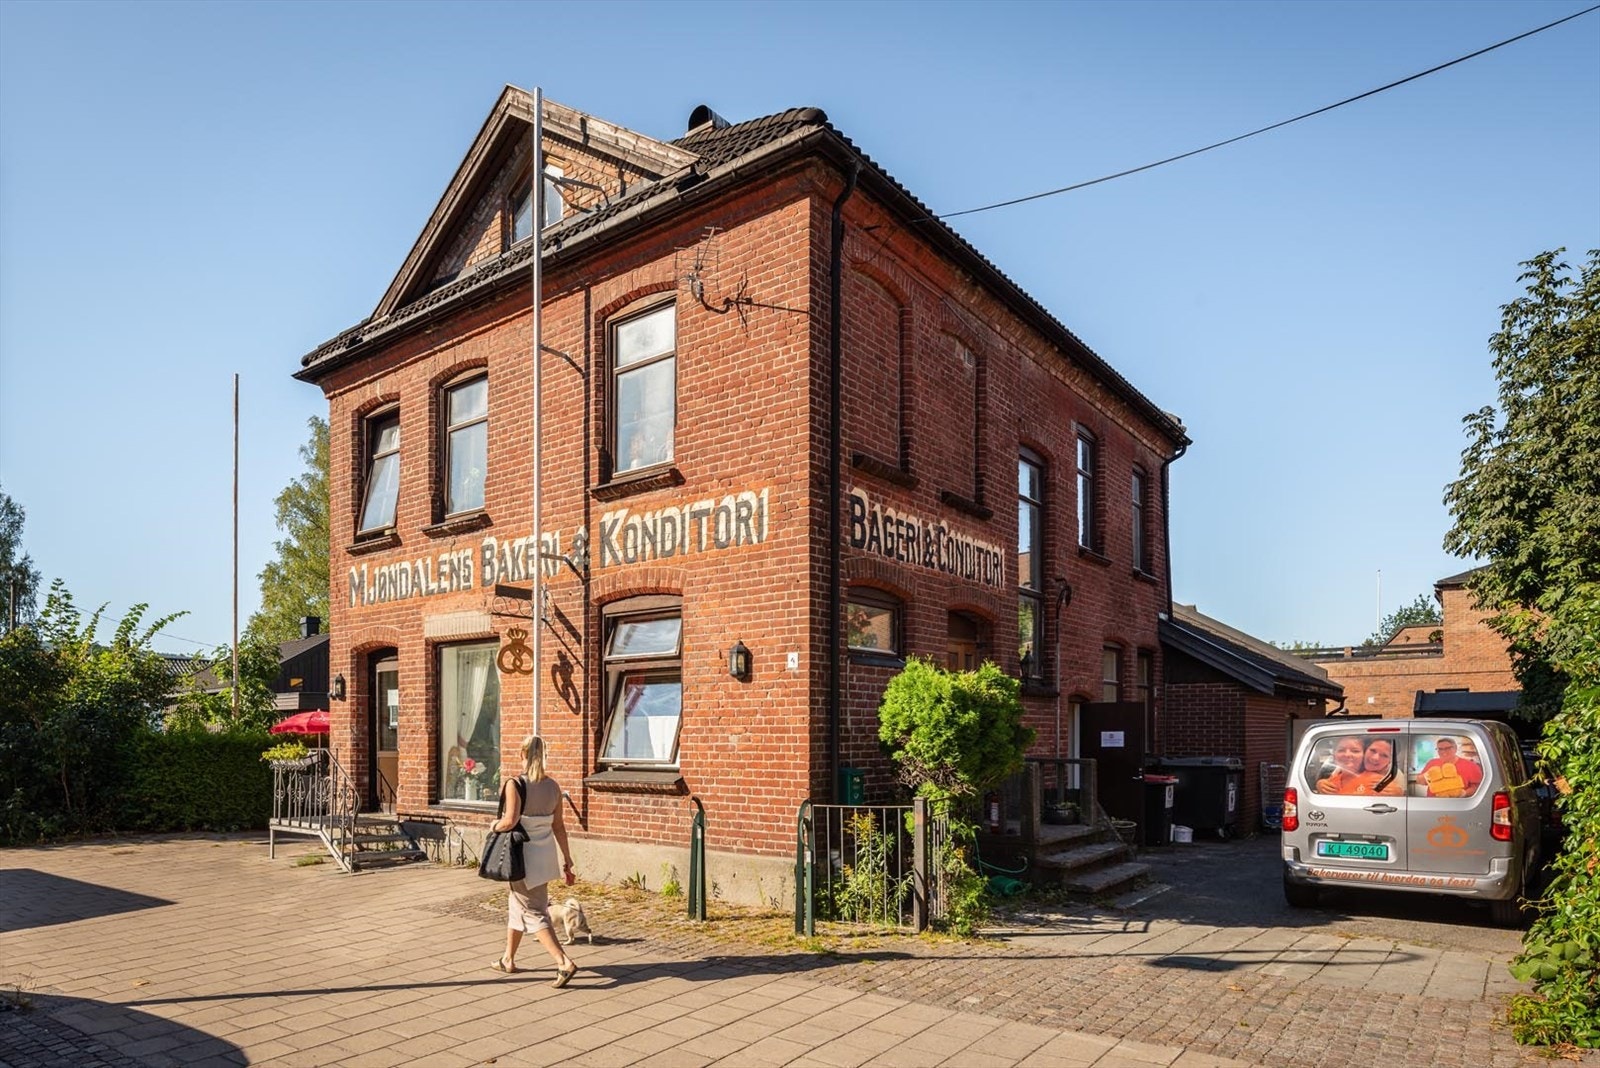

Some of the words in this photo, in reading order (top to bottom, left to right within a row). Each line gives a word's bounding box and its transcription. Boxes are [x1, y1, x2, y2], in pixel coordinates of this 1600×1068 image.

[348, 548, 473, 608] MJØNDALENS
[481, 532, 560, 587] BAKERI
[600, 489, 769, 568] KONDITORI
[850, 487, 923, 566] BAGERI
[924, 522, 936, 570] &
[937, 520, 1005, 590] CONDITORI
[1307, 867, 1364, 880] Bakervarer
[1367, 872, 1379, 881] til
[1381, 872, 1426, 886] hverdag
[1430, 878, 1444, 888] og
[1447, 875, 1476, 887] fest!
[1328, 844, 1342, 852] KJ
[1346, 846, 1383, 856] 49040
